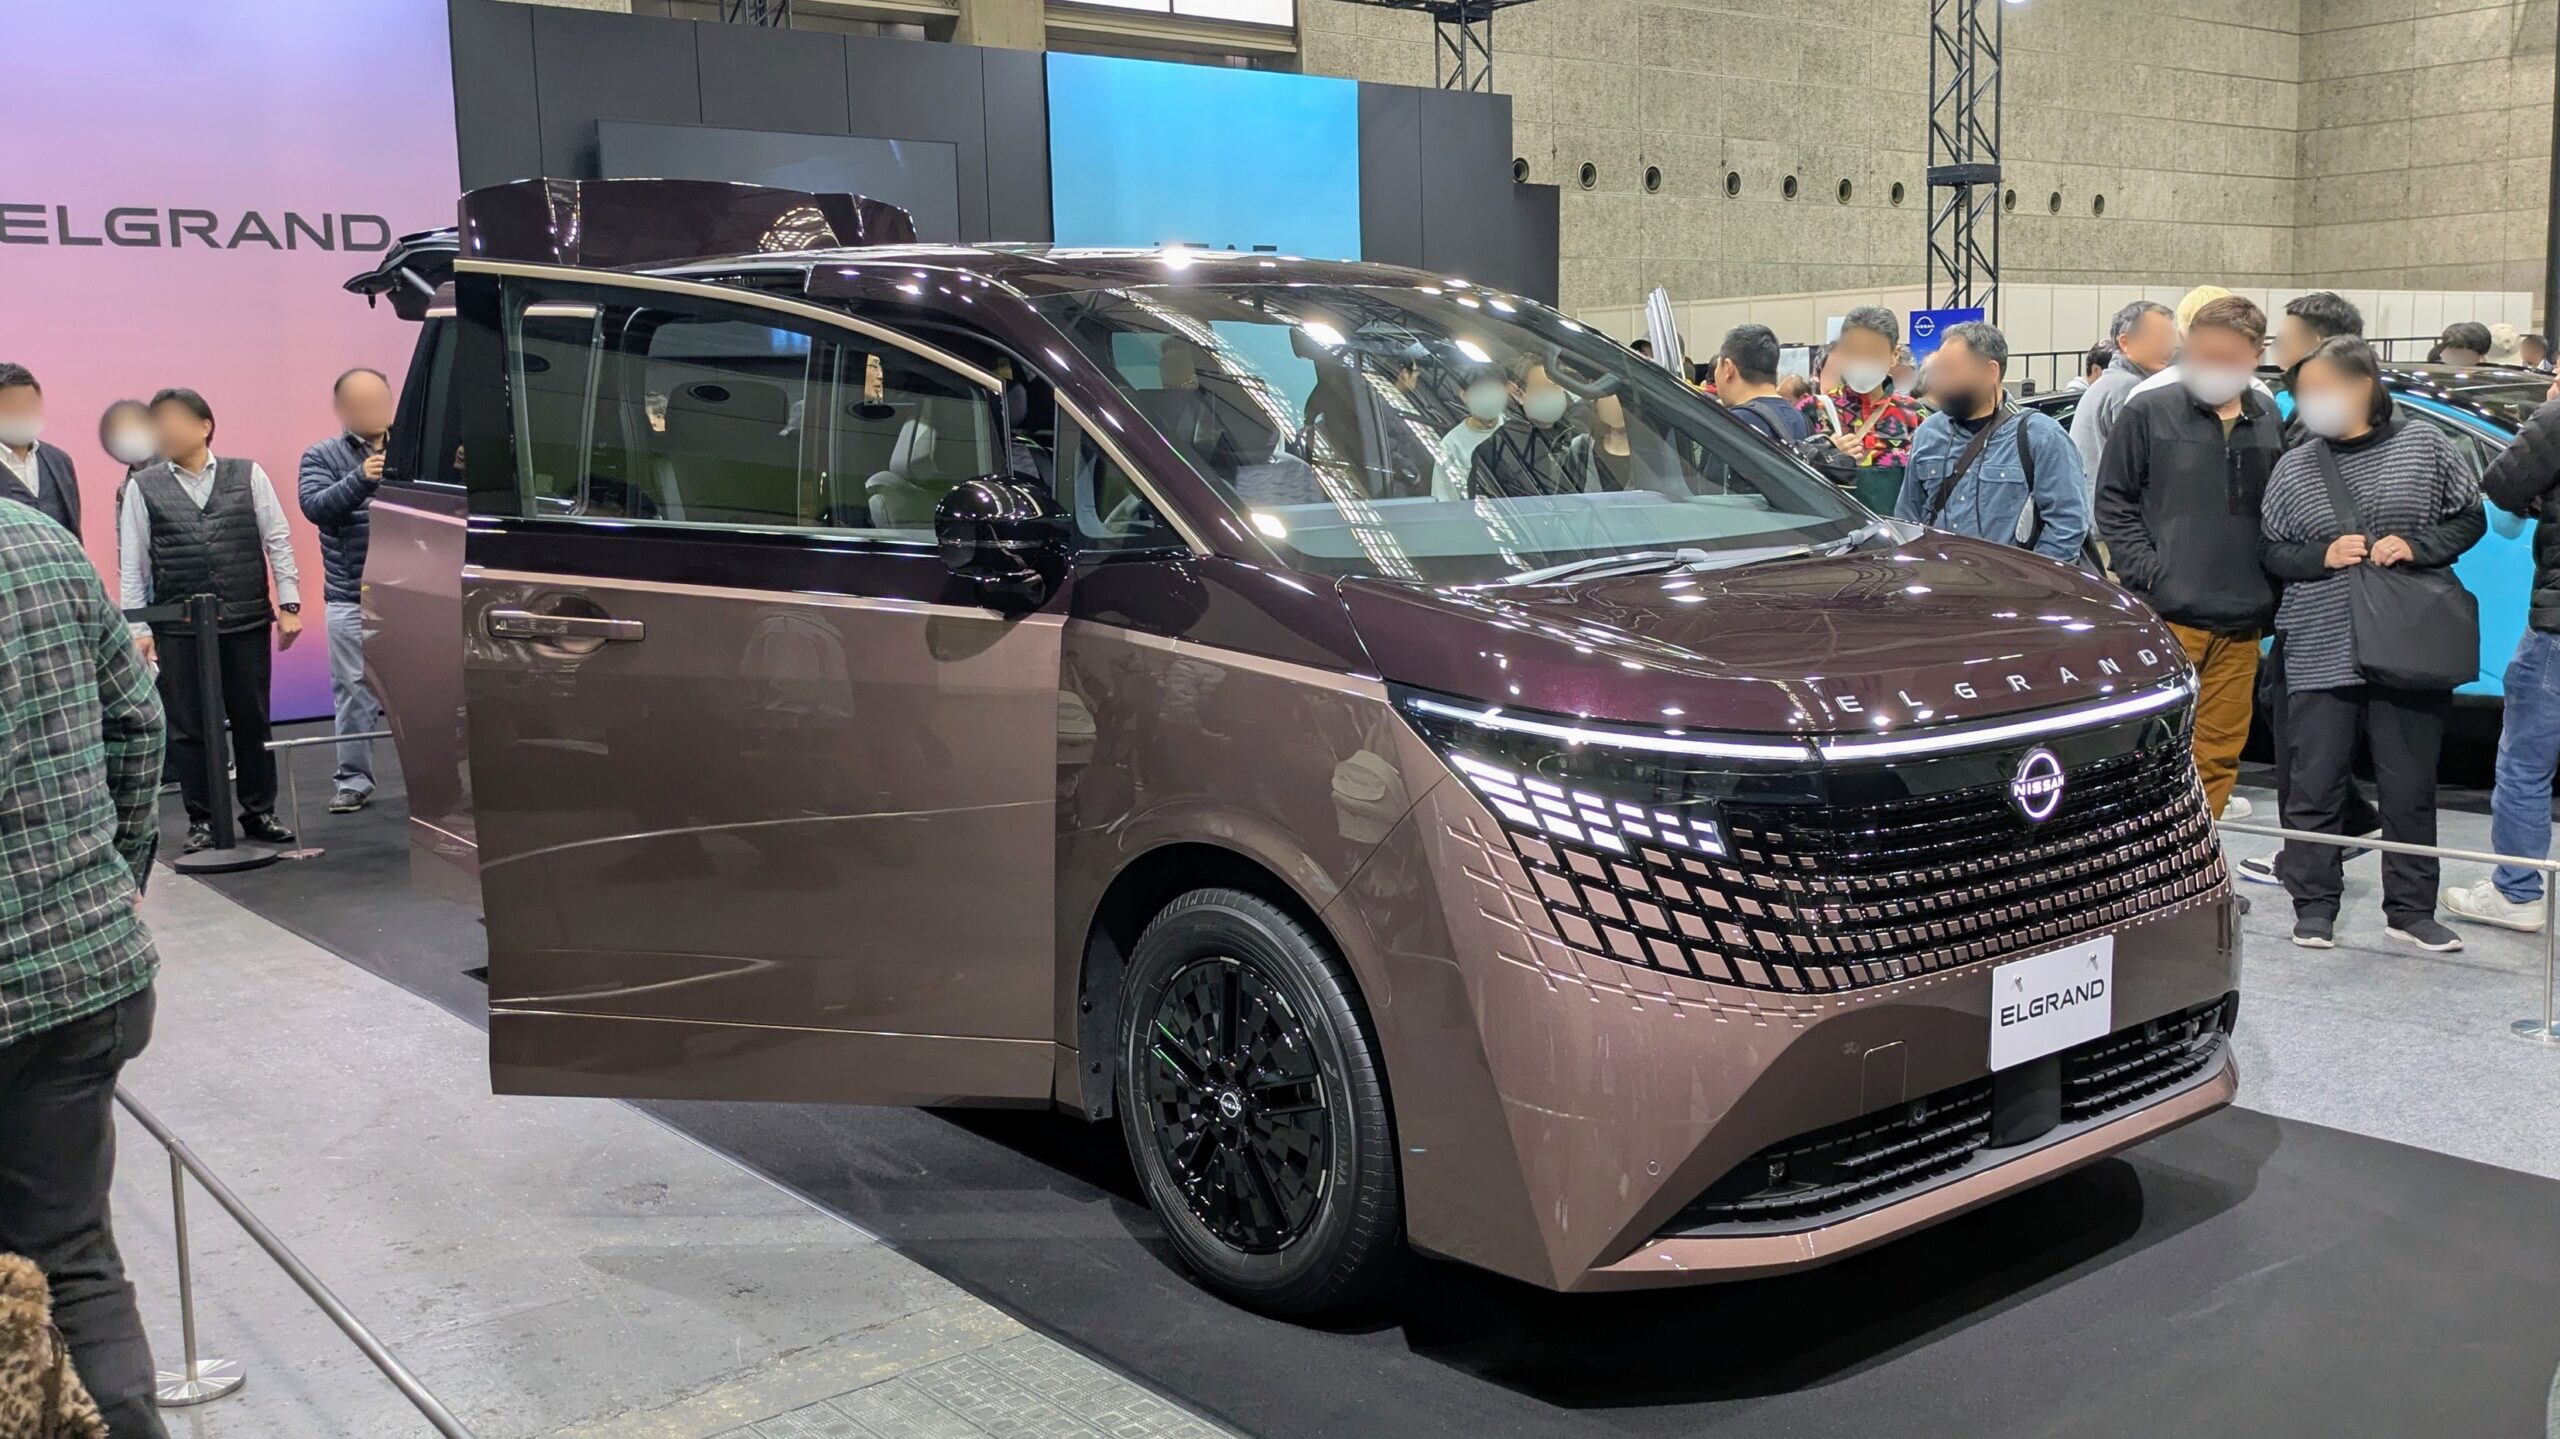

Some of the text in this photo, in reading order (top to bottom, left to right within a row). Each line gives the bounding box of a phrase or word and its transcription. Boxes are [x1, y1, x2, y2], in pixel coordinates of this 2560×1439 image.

[0, 203, 392, 252] ELGRAND
[1835, 649, 2158, 713] ELGRAND
[2013, 774, 2064, 797] NISSAN
[2001, 978, 2105, 1027] ELGRAND
